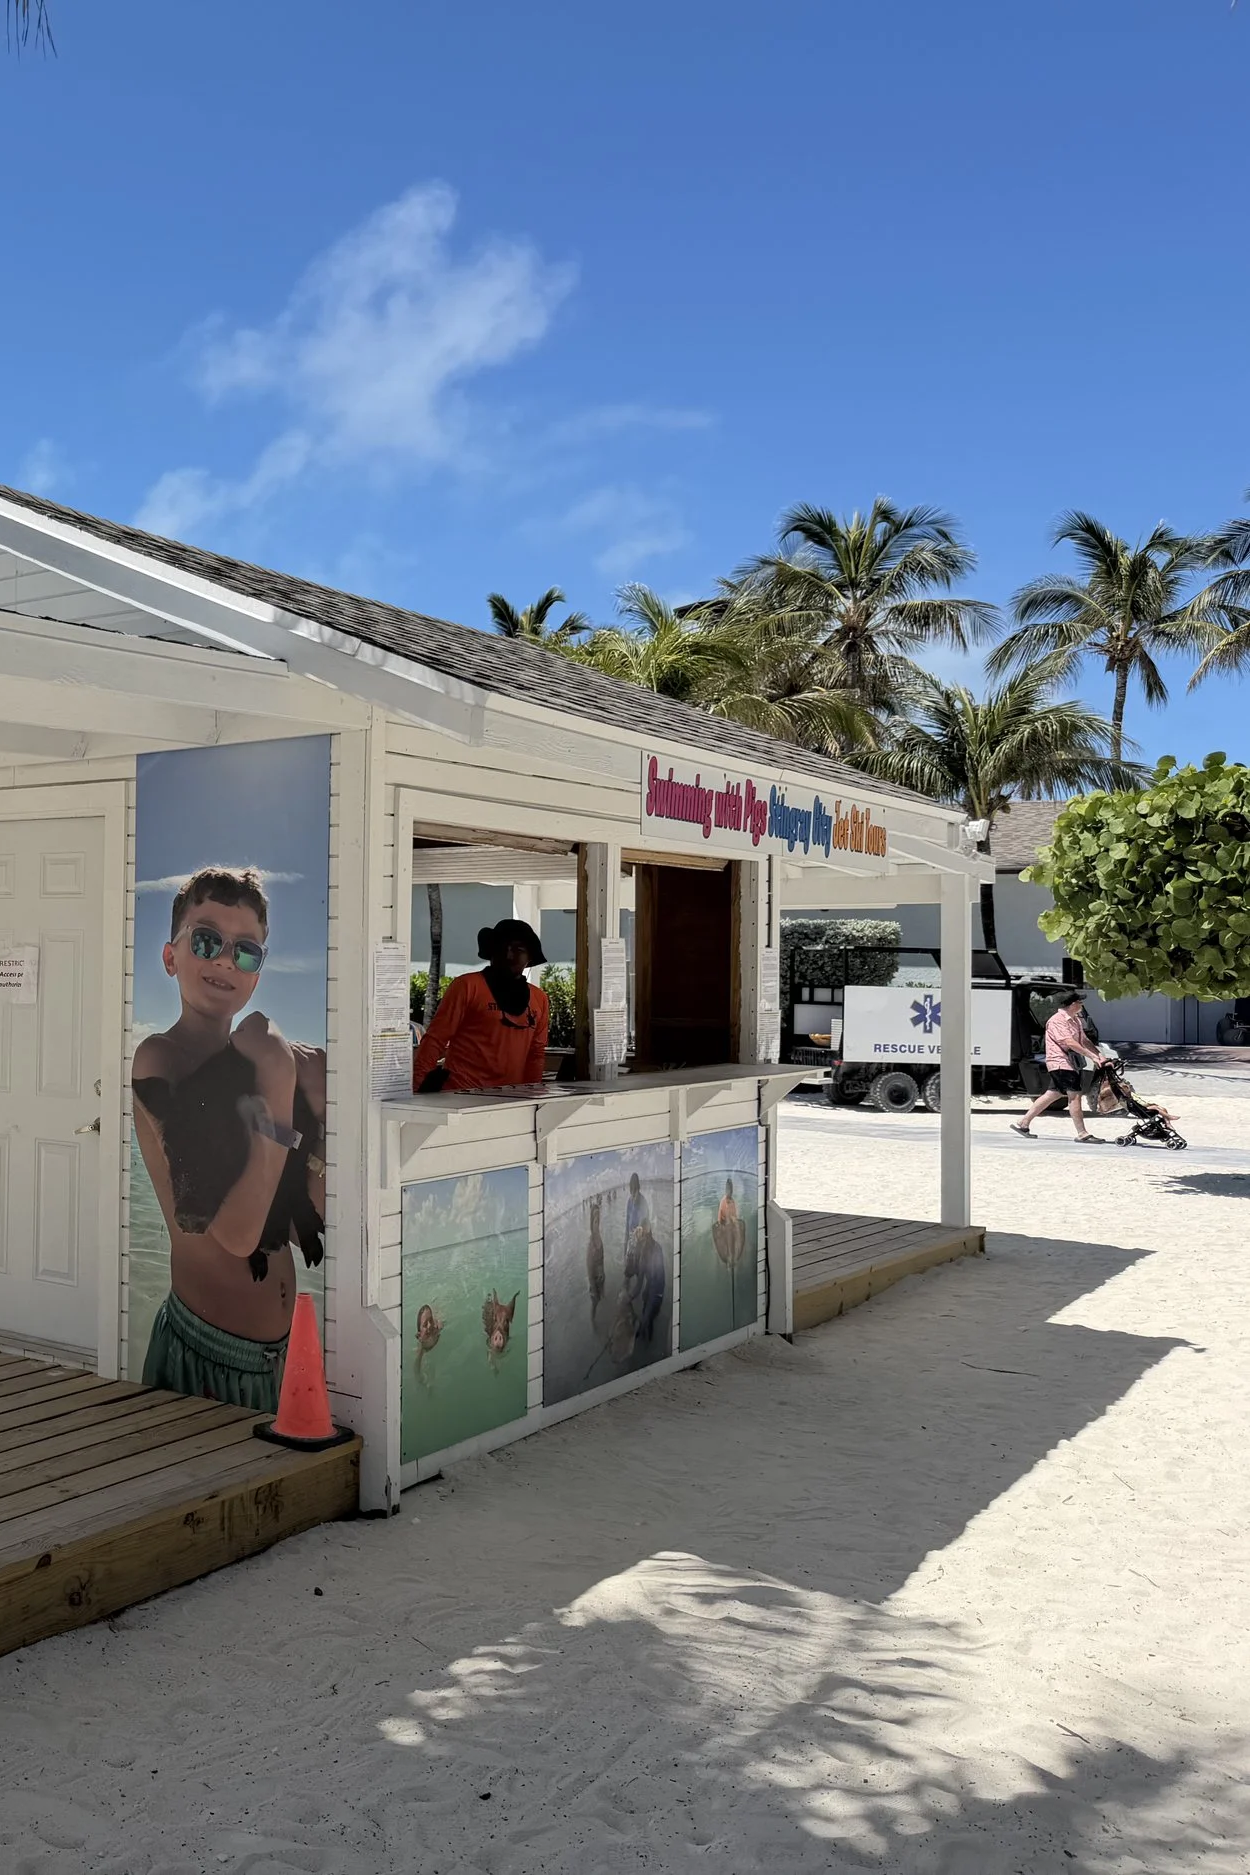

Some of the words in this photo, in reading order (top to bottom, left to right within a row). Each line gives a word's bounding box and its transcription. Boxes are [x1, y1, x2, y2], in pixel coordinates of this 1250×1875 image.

[646, 756, 714, 839] Swimming
[714, 781, 743, 831] with
[743, 779, 768, 847] Pigs
[768, 784, 812, 855] Stingray
[812, 795, 833, 858] City
[833, 800, 849, 850] Jet
[850, 804, 865, 853] Ski
[865, 808, 887, 858] Tours
[874, 1043, 924, 1054] RESCUE
